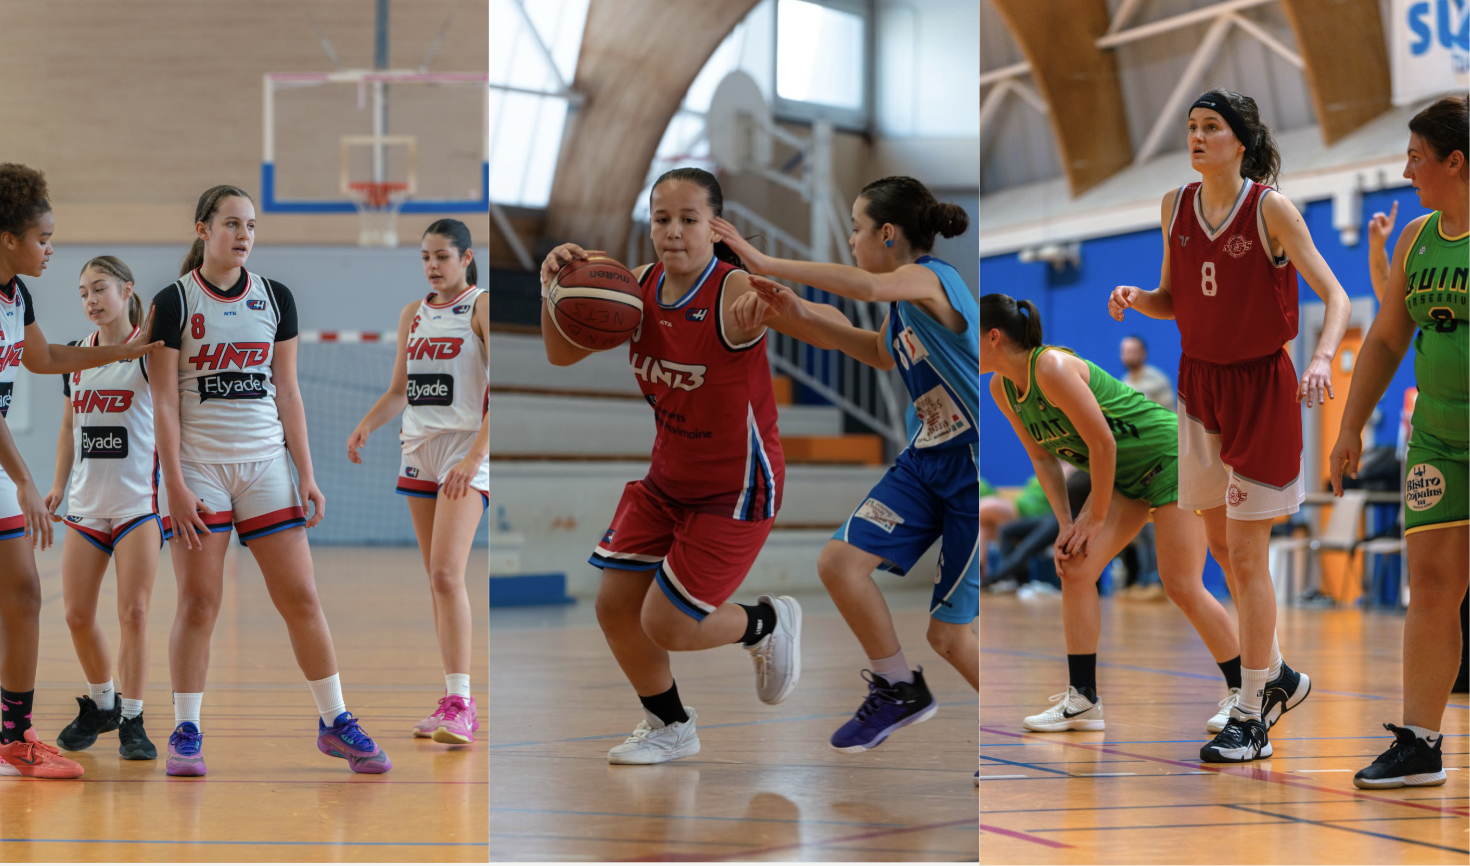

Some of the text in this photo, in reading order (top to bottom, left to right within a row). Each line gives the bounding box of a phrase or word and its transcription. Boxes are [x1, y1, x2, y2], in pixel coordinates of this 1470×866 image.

[589, 270, 630, 284] molten
[1201, 261, 1217, 296] 8
[191, 313, 205, 340] 8
[188, 342, 270, 371] HNB
[407, 336, 464, 361] HNB
[631, 352, 707, 392] HNB
[205, 374, 262, 397] Elyade
[72, 389, 134, 414] HNB
[1407, 477, 1441, 492] Bistro
